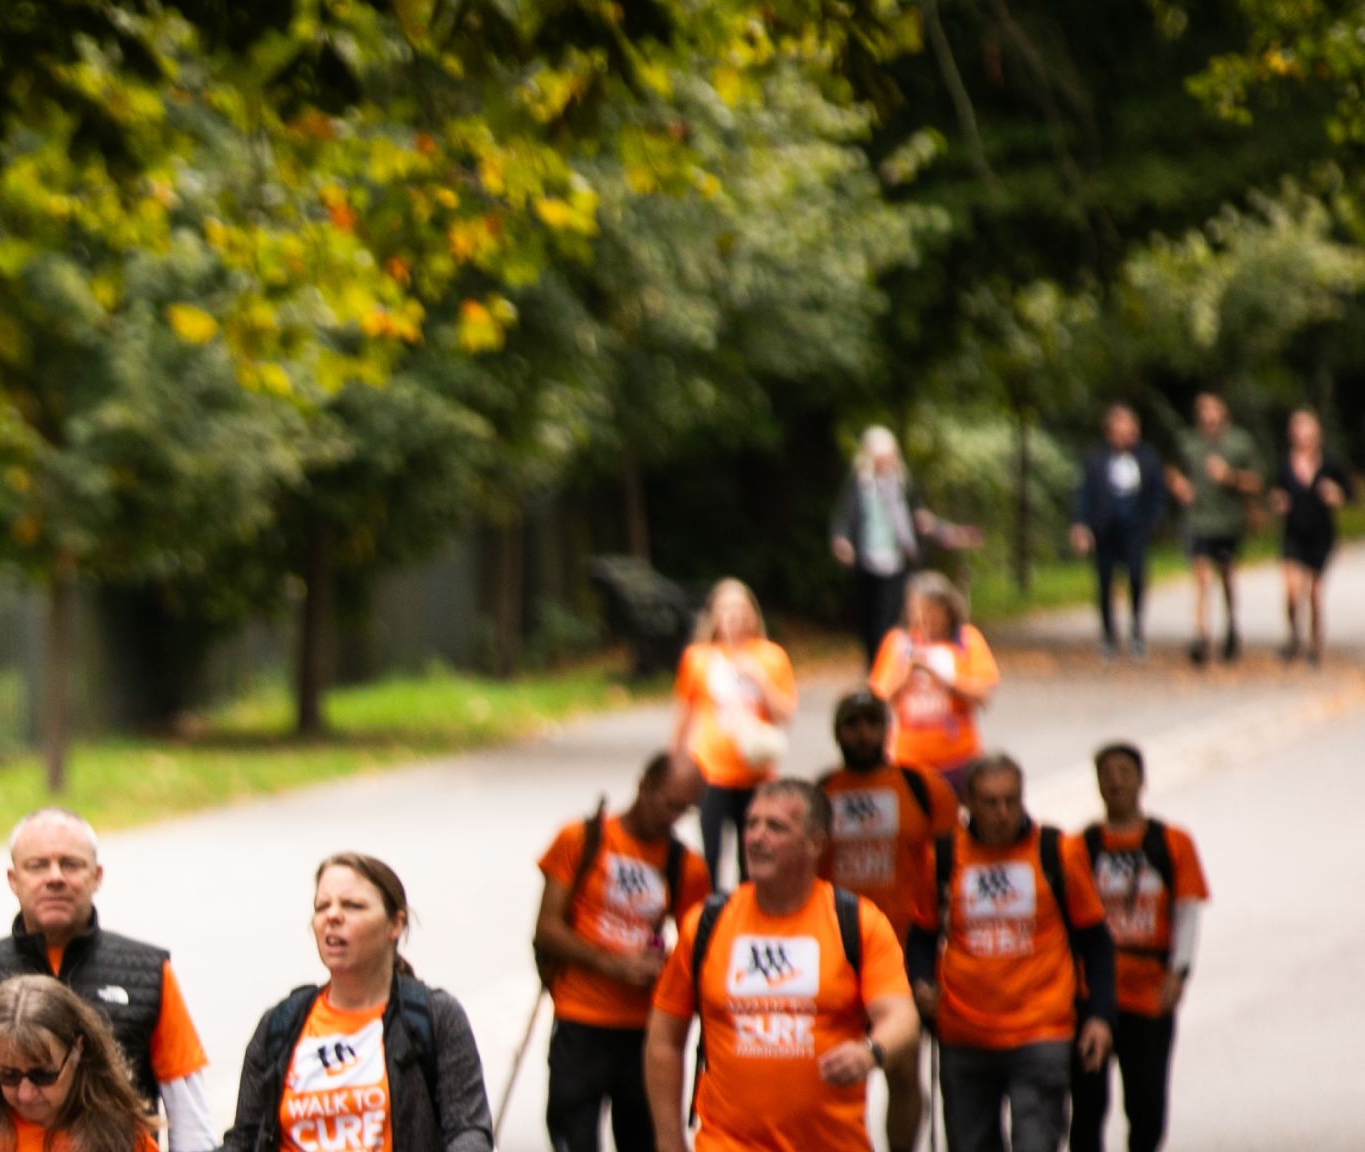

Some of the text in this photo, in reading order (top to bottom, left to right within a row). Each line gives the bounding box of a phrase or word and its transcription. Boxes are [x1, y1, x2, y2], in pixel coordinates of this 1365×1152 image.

[735, 1014, 815, 1044] CURE
[287, 1088, 386, 1119] WALK TO
